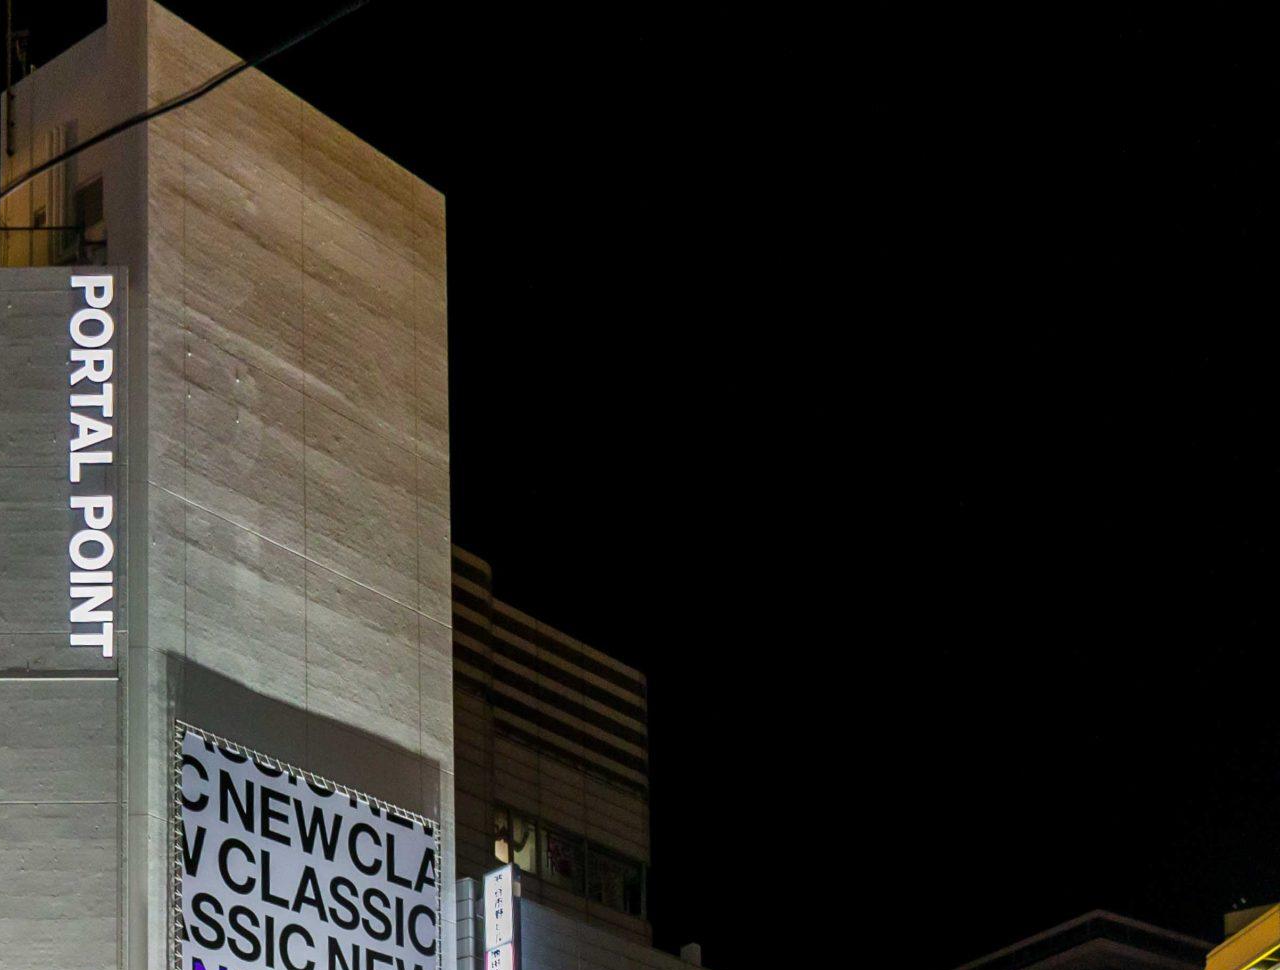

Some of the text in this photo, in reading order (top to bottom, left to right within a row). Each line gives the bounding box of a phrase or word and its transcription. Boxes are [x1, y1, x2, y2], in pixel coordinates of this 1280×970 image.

[69, 275, 115, 658] PORTAL POINT
[220, 769, 342, 862] NEW
[218, 838, 437, 957] CLASSIC
